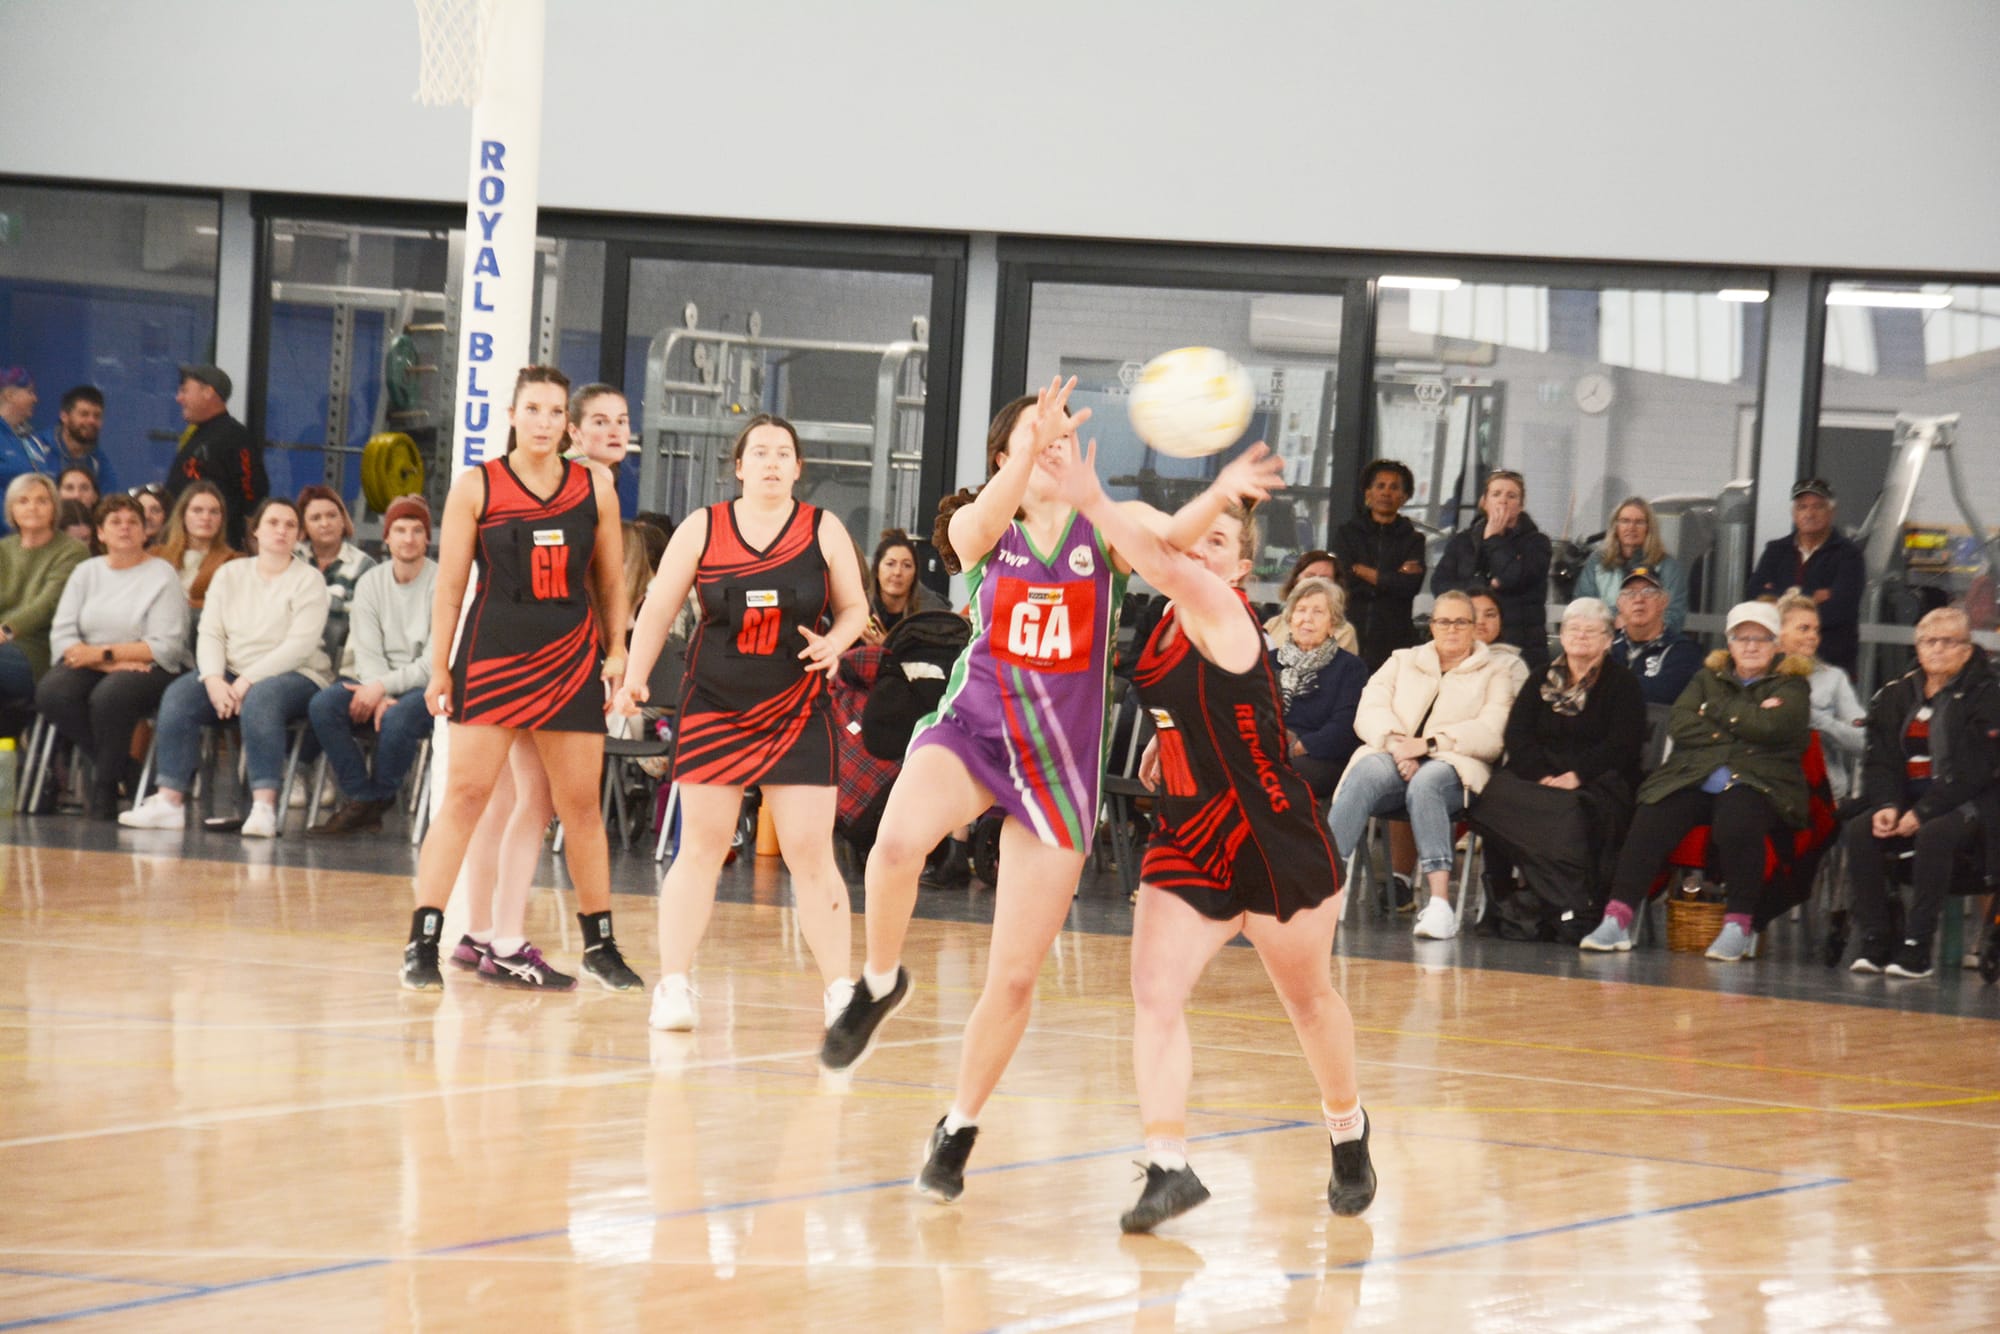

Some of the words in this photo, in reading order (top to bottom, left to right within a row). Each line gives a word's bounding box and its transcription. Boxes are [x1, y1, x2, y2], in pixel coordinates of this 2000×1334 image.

[473, 140, 506, 312] ROYAL
[463, 332, 494, 467] BLUE
[531, 545, 570, 600] GK
[737, 607, 782, 655] GD
[1008, 602, 1072, 659] GA
